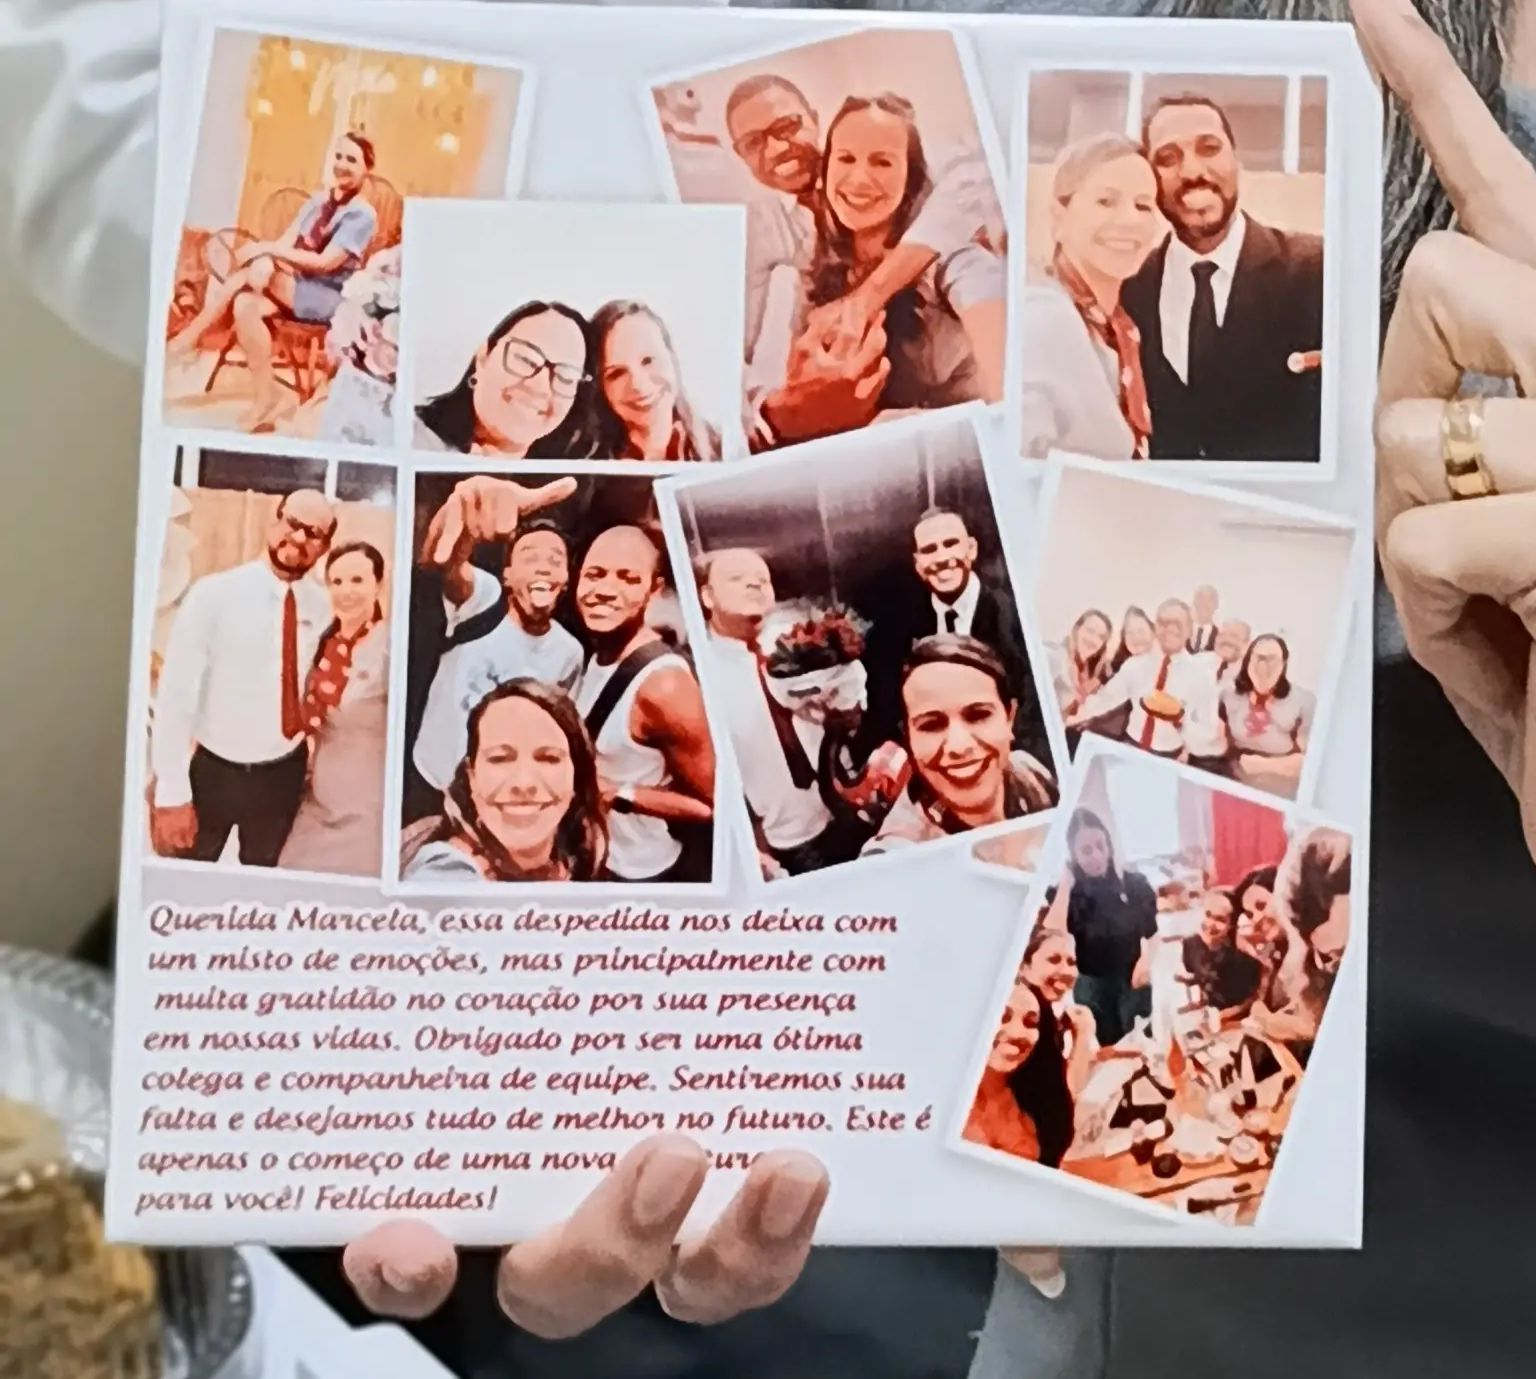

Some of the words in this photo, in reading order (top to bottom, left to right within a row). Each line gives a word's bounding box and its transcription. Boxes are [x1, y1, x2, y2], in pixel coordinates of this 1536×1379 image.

[149, 904, 277, 937] Querida
[286, 906, 428, 935] Marcela,
[439, 913, 503, 932] essa
[513, 906, 670, 936] despedida
[679, 913, 732, 933] nos
[741, 907, 826, 933] deixa
[833, 914, 899, 934] com
[147, 951, 197, 972] um
[206, 944, 294, 972] misto
[302, 947, 340, 972] de
[349, 945, 488, 977] emoções,
[499, 952, 564, 972] mas
[572, 945, 814, 978] principalmente
[822, 953, 887, 974] com
[153, 984, 249, 1012] muita
[253, 984, 398, 1018] gratidão
[405, 991, 446, 1012] no
[454, 984, 582, 1018] coração
[587, 992, 644, 1018] por
[652, 991, 709, 1012] sua
[715, 991, 857, 1018] presença
[142, 1031, 191, 1052] em
[198, 1030, 301, 1052] nossas
[312, 1024, 401, 1052] vidas.
[414, 1024, 563, 1058] Obrigado
[569, 1031, 627, 1057] por
[634, 1031, 683, 1052] ser
[693, 1032, 764, 1052] uma
[772, 1025, 864, 1052] ótima
[141, 1066, 245, 1098] colega
[253, 1071, 272, 1092] e
[280, 1064, 491, 1097] companheira
[499, 1065, 538, 1092] de
[545, 1063, 658, 1097] equipe.
[668, 1063, 843, 1092] Sentiremos
[849, 1071, 906, 1093] sua
[138, 1105, 217, 1134] falta
[227, 1111, 245, 1132] e
[253, 1104, 416, 1137] desejamos
[424, 1106, 497, 1131] tudo
[505, 1106, 544, 1131] de
[551, 1105, 666, 1132] melhor
[674, 1111, 715, 1132] no
[721, 1104, 833, 1135] futuro.
[845, 1104, 907, 1133] Este
[914, 1104, 933, 1132] é
[137, 1151, 249, 1177] apenas
[259, 1152, 280, 1172] o
[287, 1151, 405, 1178] começo
[413, 1146, 452, 1172] de
[461, 1151, 532, 1171] uma
[540, 1151, 616, 1171] nova
[134, 1192, 214, 1217] para
[224, 1184, 306, 1212] você!
[314, 1184, 499, 1212] Felicidades!
